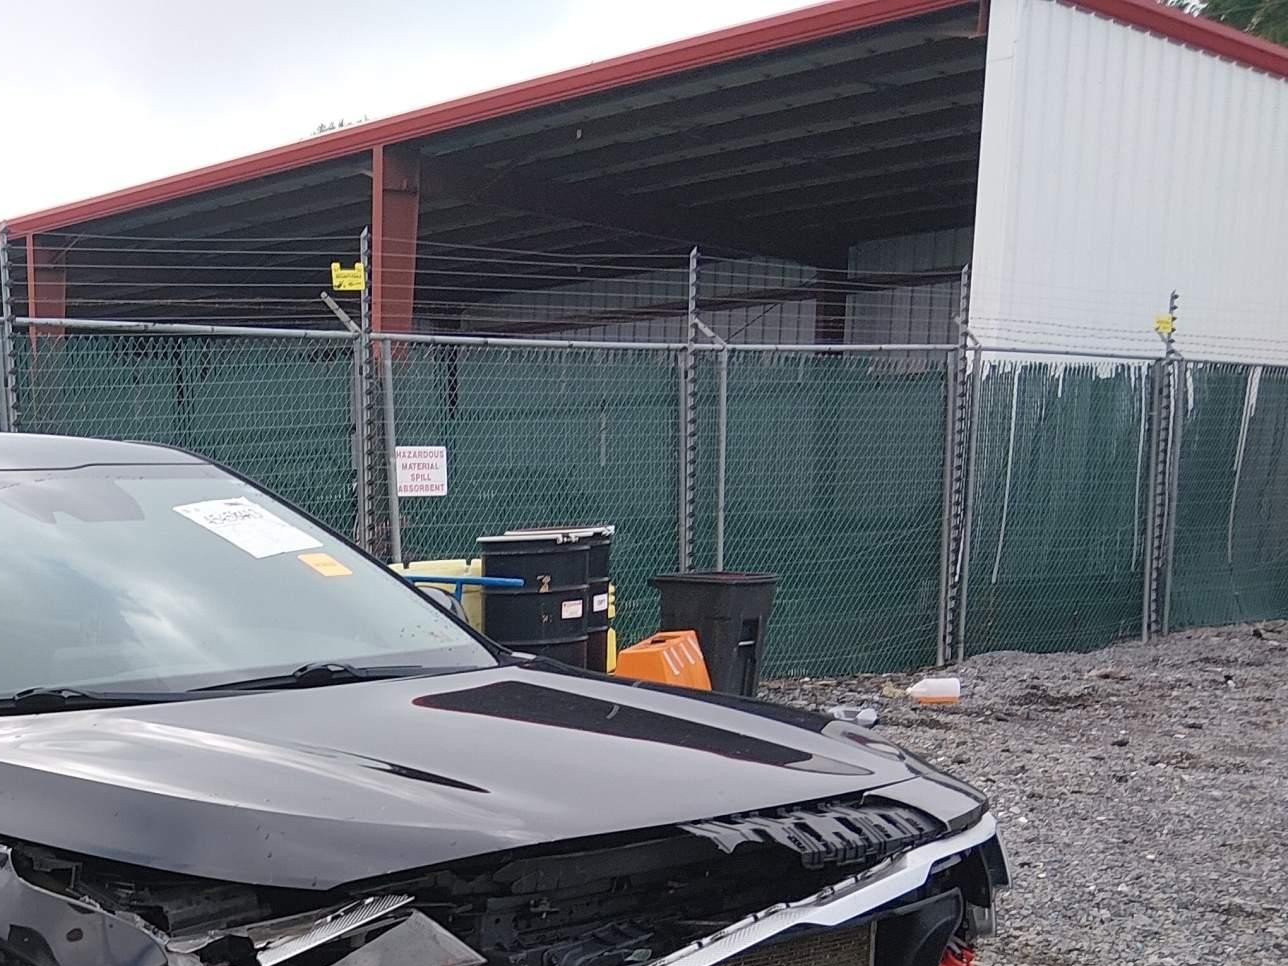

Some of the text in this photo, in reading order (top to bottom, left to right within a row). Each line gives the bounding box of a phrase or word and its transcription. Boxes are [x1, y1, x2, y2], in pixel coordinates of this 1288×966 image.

[396, 450, 445, 459] HAZARDOUS
[401, 462, 440, 471] MATERIAL
[410, 472, 432, 482] SPILL
[398, 483, 446, 493] ABSORBENT
